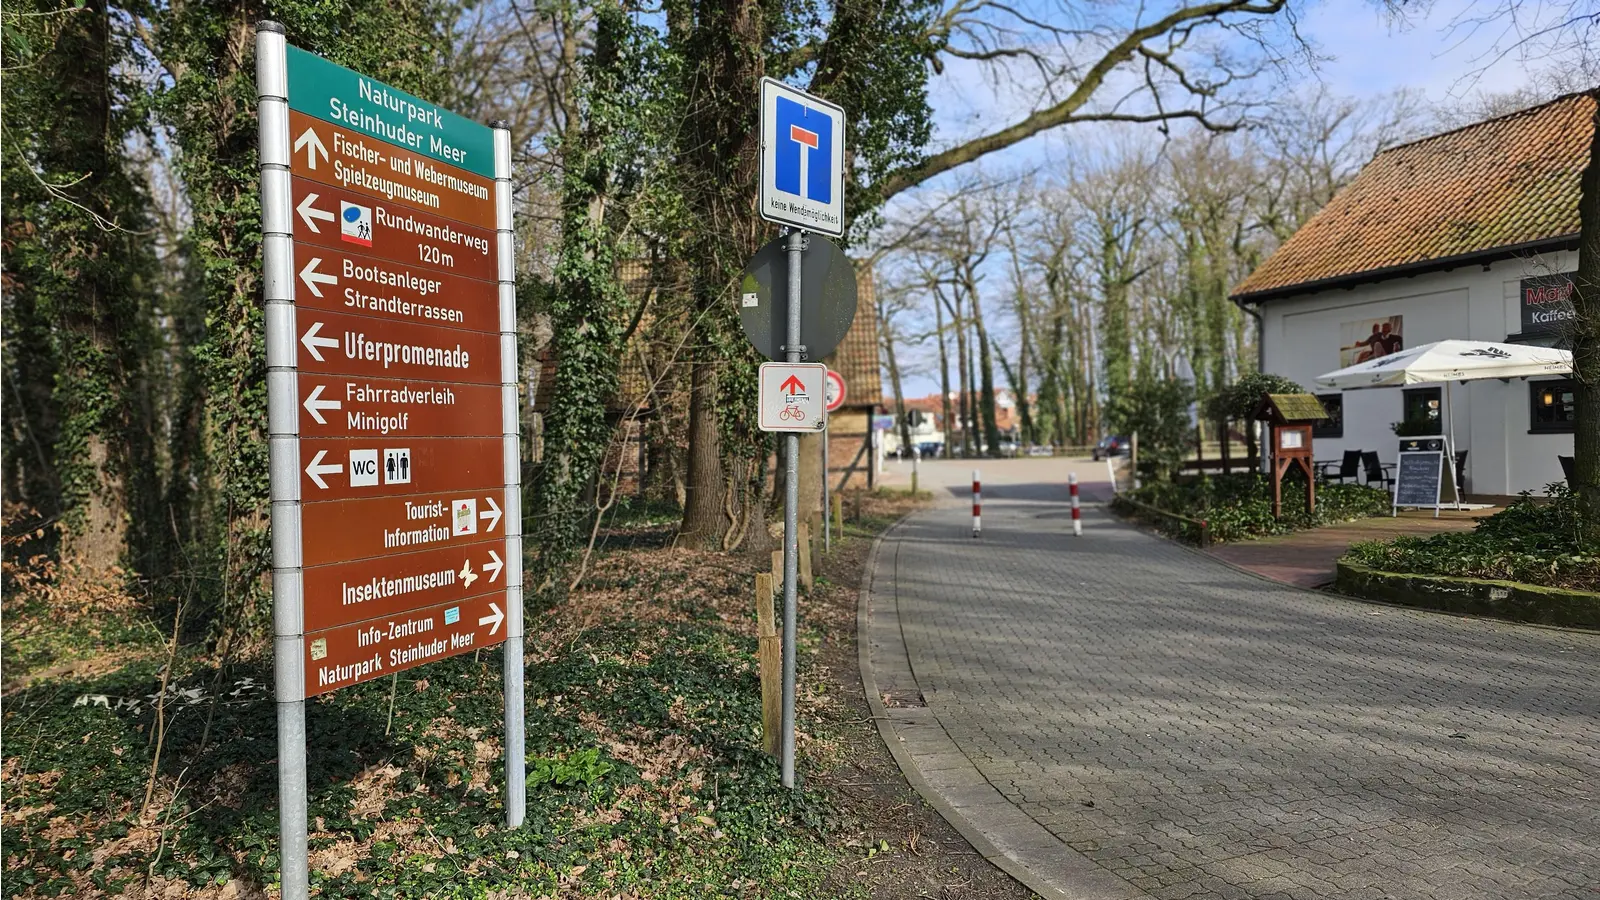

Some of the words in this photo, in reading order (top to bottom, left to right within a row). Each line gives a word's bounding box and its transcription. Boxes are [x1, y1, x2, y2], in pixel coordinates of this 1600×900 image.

[359, 78, 442, 129] Naturpark
[330, 98, 423, 148] Steinhuder
[431, 135, 466, 163] Meer
[334, 132, 386, 165] Fischer-
[391, 157, 410, 175] und
[414, 160, 488, 200] Webermuseum
[335, 160, 439, 208] Spielzeugmuseum
[770, 197, 787, 211] keine
[376, 207, 488, 255] Rundwanderweg
[344, 259, 441, 294] Bootsanleger
[345, 288, 463, 322] Strandterrassen
[1532, 309, 1575, 324] Kaffee
[345, 332, 468, 368] Uferpromenade
[347, 383, 454, 404] Fahrradverleih
[348, 412, 408, 434] Minigolf
[352, 460, 376, 475] WC
[405, 500, 448, 520] Tourist-
[385, 524, 449, 548] Information
[343, 570, 454, 605] Insektenmuseum
[358, 618, 433, 647] Info-Zentrum
[320, 654, 382, 686] Naturpark
[390, 638, 447, 666] Steinhuder
[451, 633, 474, 649] Meer
